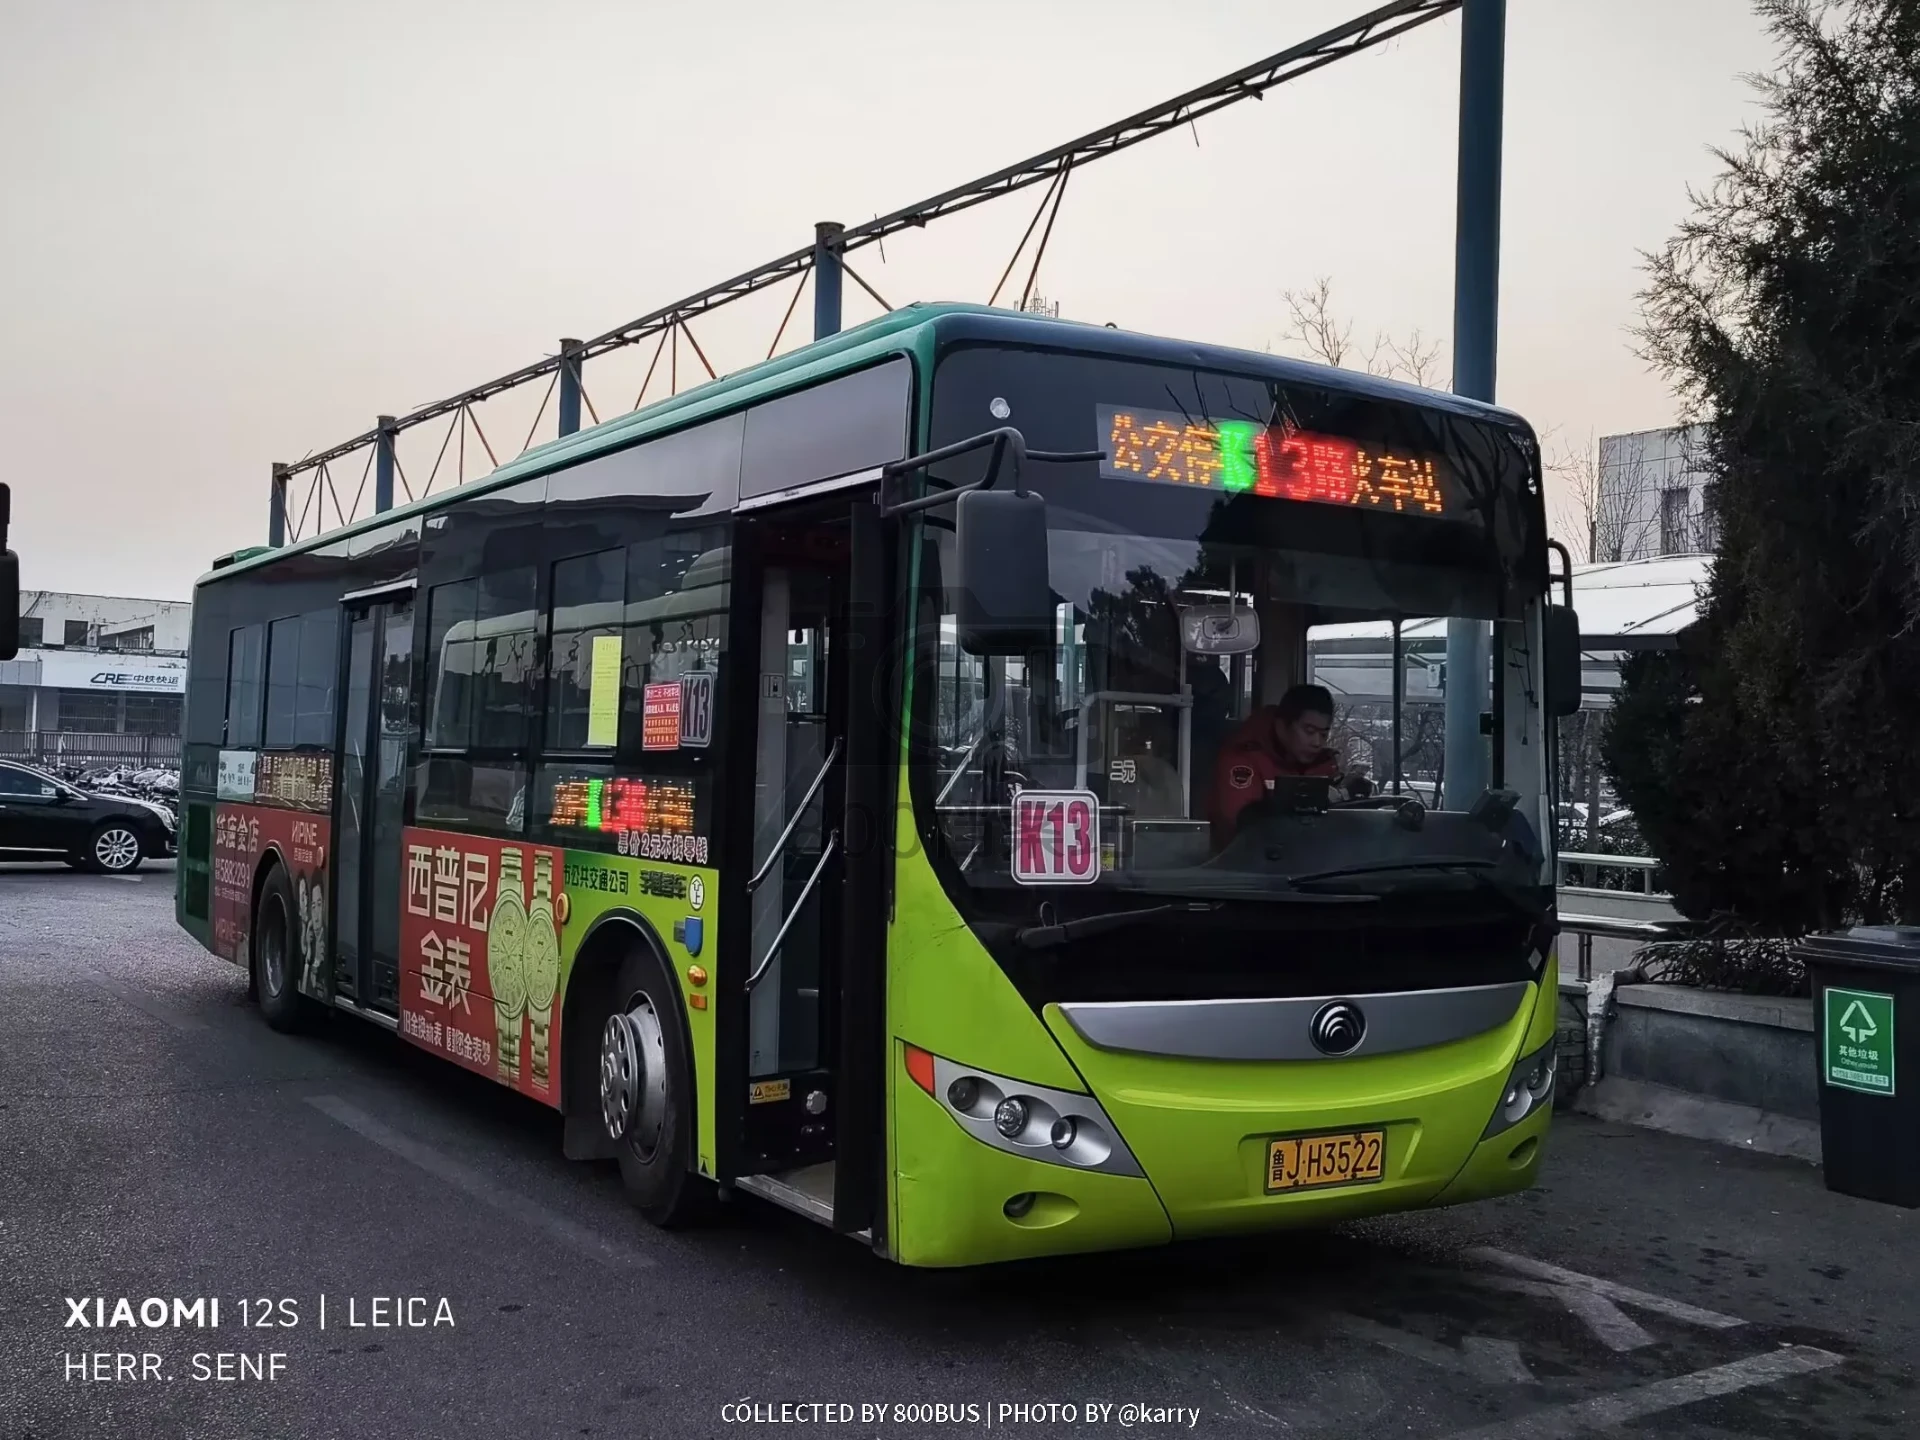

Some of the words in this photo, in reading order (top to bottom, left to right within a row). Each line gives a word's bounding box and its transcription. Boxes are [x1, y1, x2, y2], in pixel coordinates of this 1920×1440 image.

[133, 675, 178, 684] 中铁快运
[684, 677, 710, 739] K13
[1110, 760, 1136, 783] 二元
[617, 829, 708, 865] 票价2元不找零钱
[1019, 800, 1092, 876] K13
[408, 844, 489, 932] 西普尼
[420, 929, 471, 1016] 金表
[403, 1008, 443, 1048] 旧金换新表
[1839, 1045, 1879, 1061] 其他垃圾
